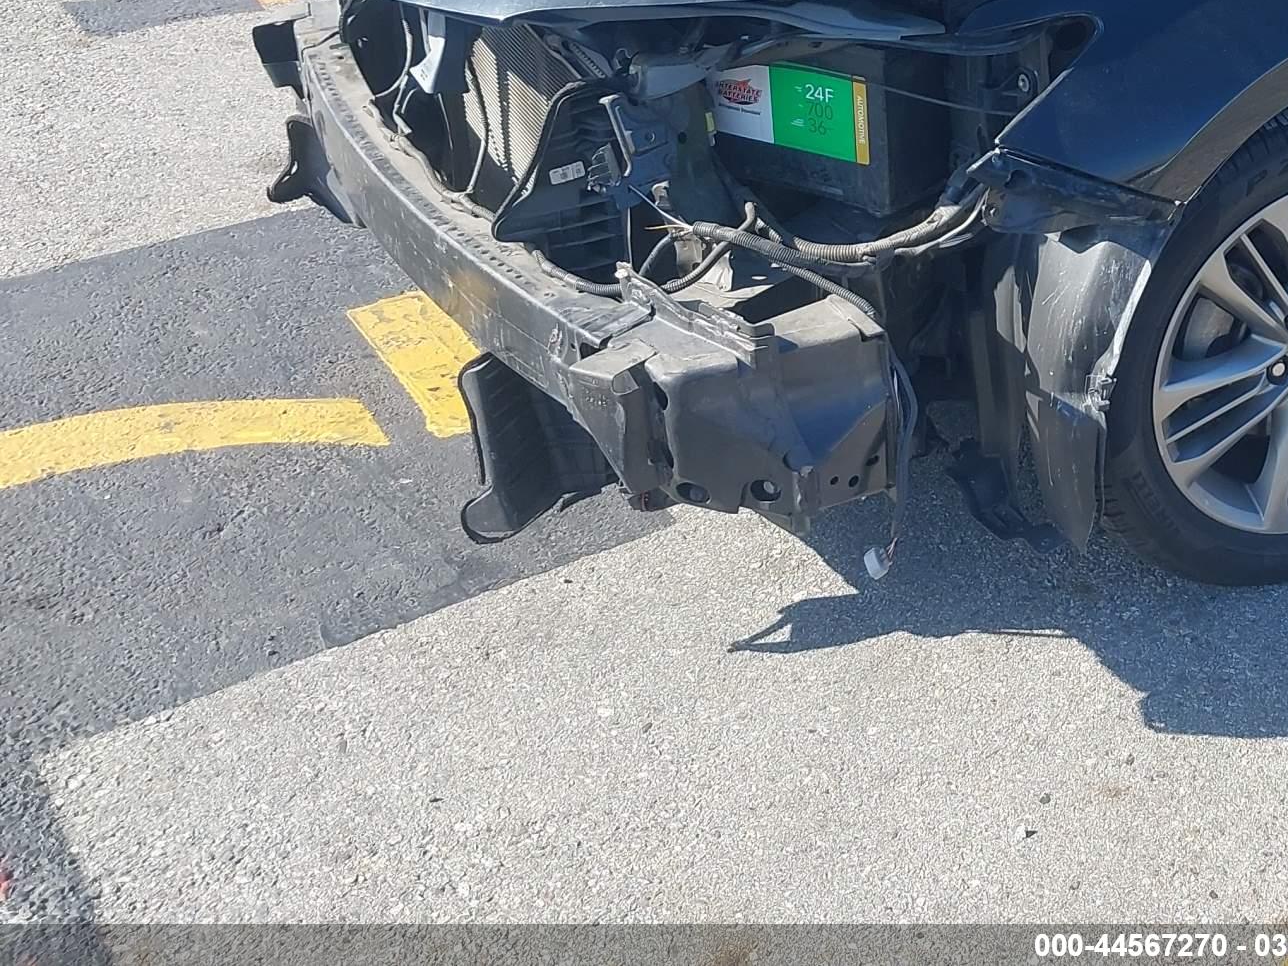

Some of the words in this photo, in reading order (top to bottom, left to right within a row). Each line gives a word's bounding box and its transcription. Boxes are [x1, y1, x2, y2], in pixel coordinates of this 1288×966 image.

[805, 83, 834, 103] 24F
[806, 100, 833, 120] 700
[856, 95, 866, 145] AUTOMOTIVE
[807, 117, 826, 136] 36
